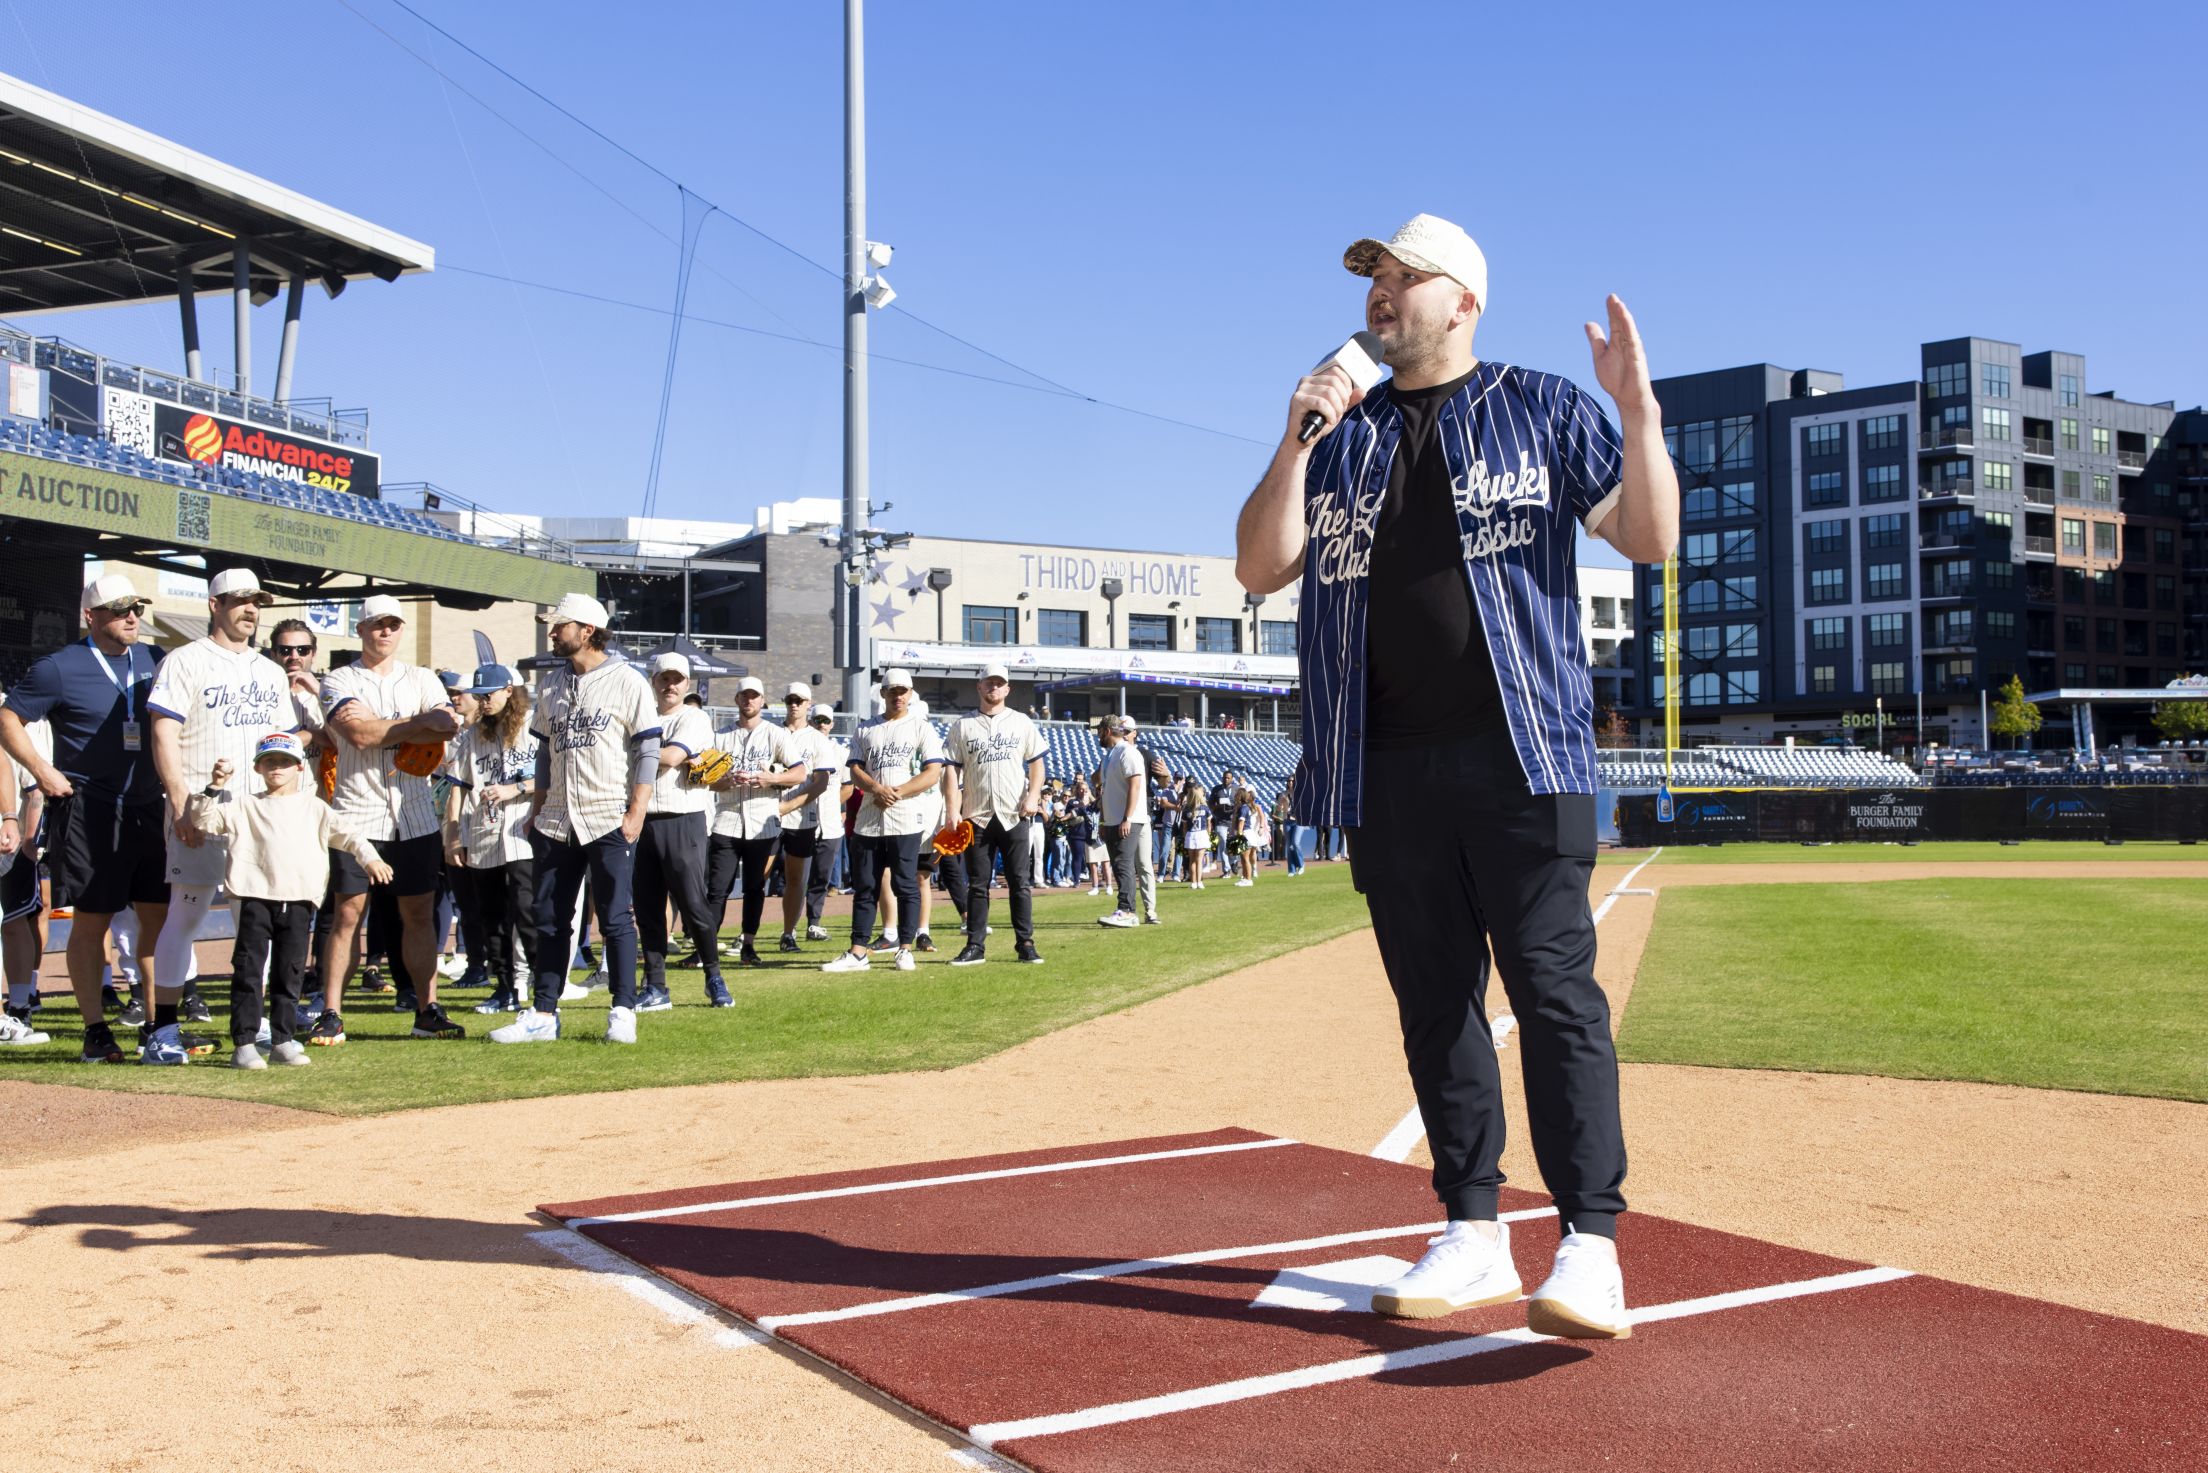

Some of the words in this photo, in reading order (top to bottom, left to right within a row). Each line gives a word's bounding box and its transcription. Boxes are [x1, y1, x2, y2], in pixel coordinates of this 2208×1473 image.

[223, 426, 352, 477] Advance
[223, 451, 308, 485] FINANCIAL
[307, 472, 351, 494] 24/7
[1452, 450, 1549, 518] Lucky
[17, 471, 139, 518] AUCTION
[1311, 492, 1349, 538] The
[274, 518, 311, 537] BURGER
[313, 524, 341, 544] FAMILY
[269, 535, 326, 558] FOUNDATION
[1019, 553, 1096, 591] THIRD
[1101, 561, 1126, 577] AND
[1130, 561, 1202, 597] HOME
[203, 684, 236, 709] The
[566, 707, 612, 733] Lucky
[554, 734, 597, 753] Classic
[867, 747, 880, 760] The
[881, 741, 915, 758] Lucky
[967, 738, 987, 755] The
[988, 731, 1021, 749] Lucky
[475, 752, 499, 775] The
[872, 757, 905, 772] Classic
[977, 750, 1012, 765] Classic
[1878, 792, 1897, 805] The
[1850, 805, 1889, 816] BURGER
[1892, 805, 1924, 817] FAMILY
[1856, 816, 1918, 828] FOUNDATION
